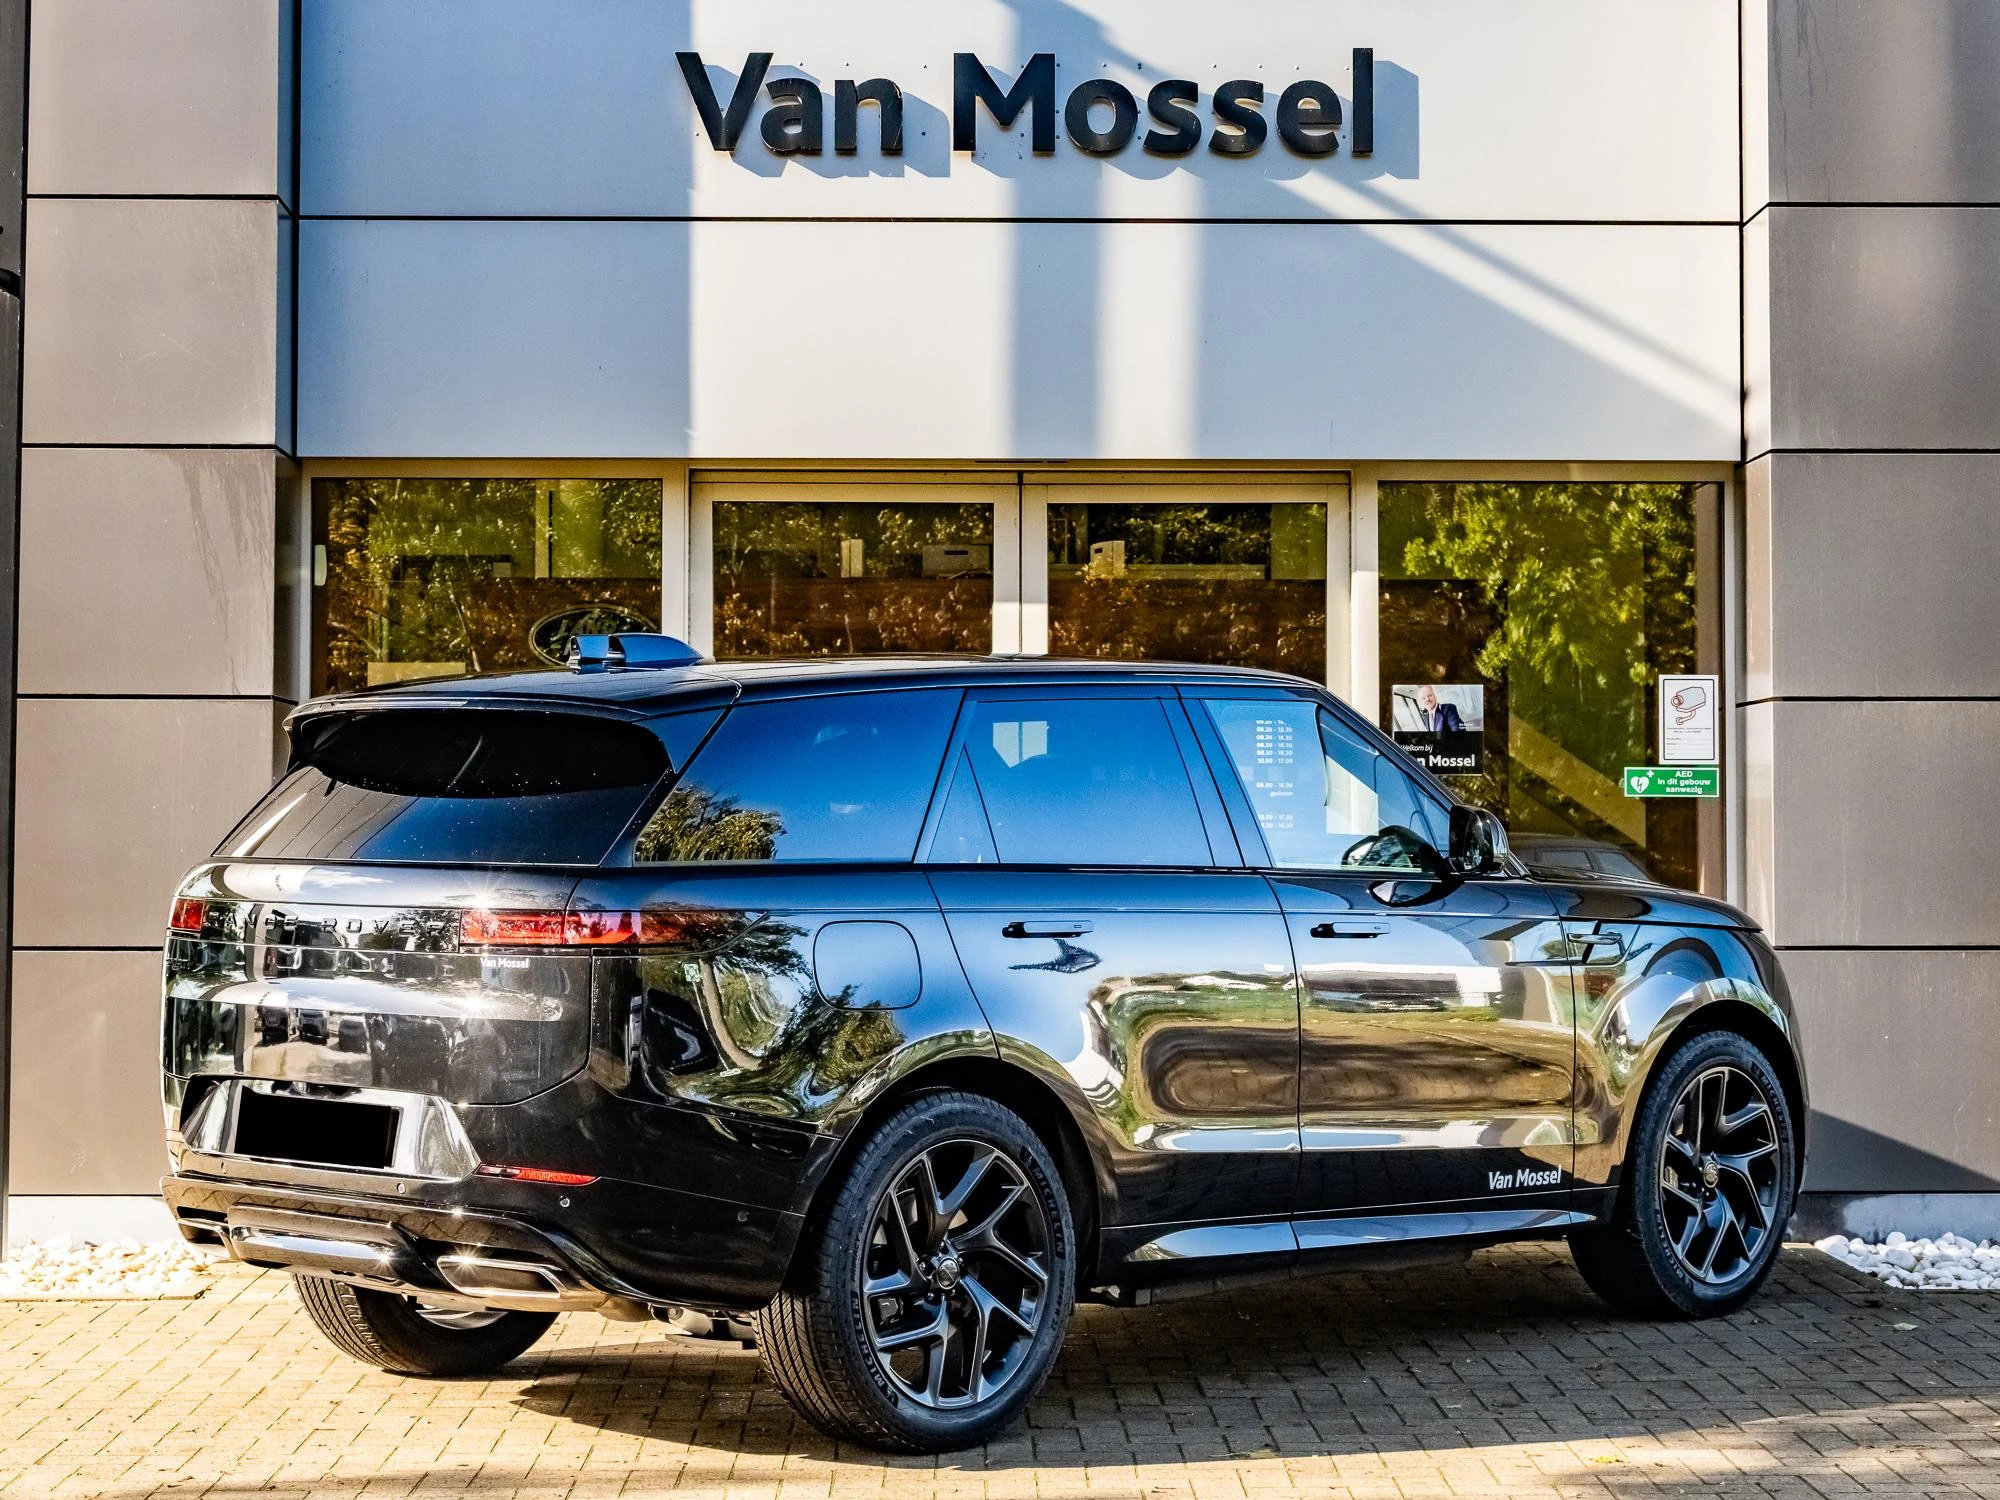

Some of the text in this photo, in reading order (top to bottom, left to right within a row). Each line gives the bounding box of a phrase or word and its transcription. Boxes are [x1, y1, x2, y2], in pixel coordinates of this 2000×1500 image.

[675, 48, 1374, 154] Van Mossel
[1429, 754, 1475, 767] Mossel
[1679, 778, 1711, 787] gebouw
[1665, 786, 1703, 794] aanwezig
[321, 917, 446, 937] ROVER
[480, 957, 530, 969] Van Mossel
[1488, 1164, 1562, 1190] Van Mossel
